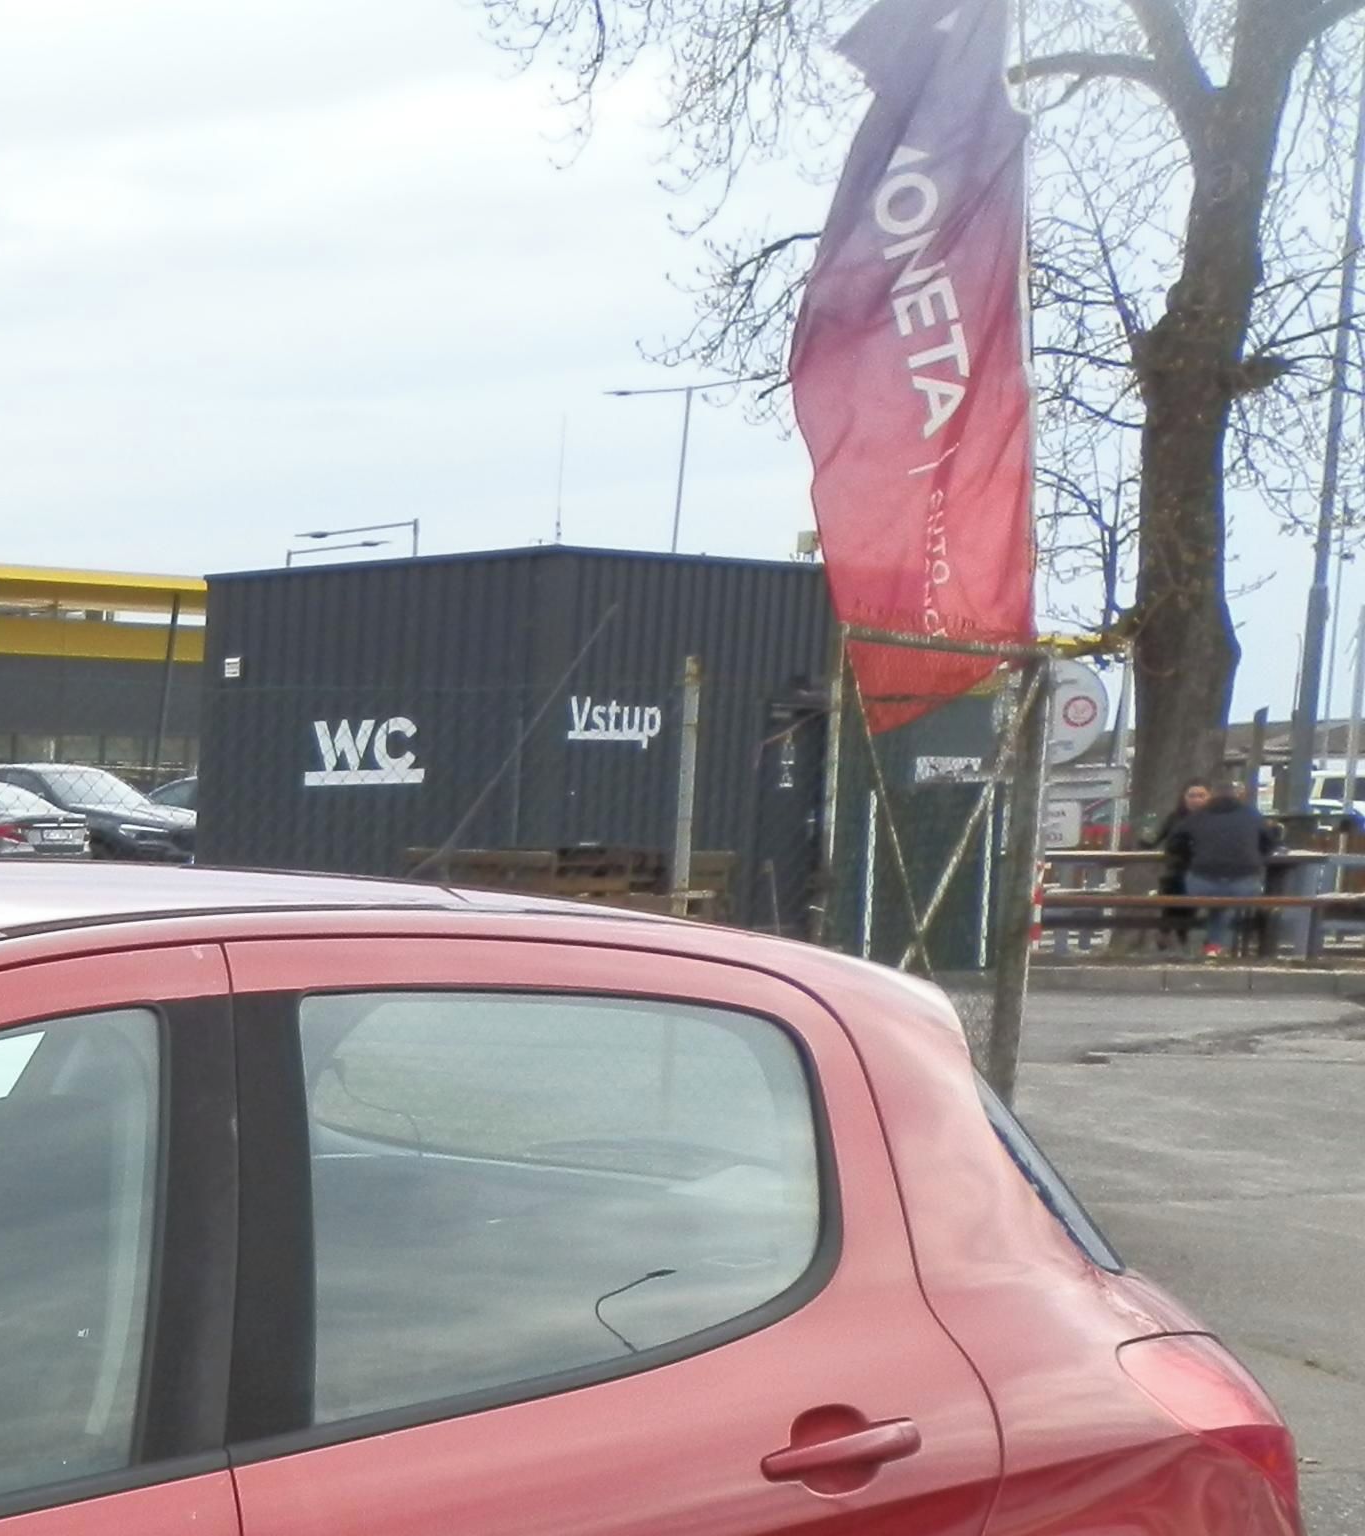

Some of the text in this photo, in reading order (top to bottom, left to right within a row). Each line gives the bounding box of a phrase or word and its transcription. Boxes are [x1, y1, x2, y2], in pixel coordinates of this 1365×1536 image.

[875, 146, 970, 440] ONETA
[314, 717, 417, 771] WC
[570, 696, 662, 748] Vstup
